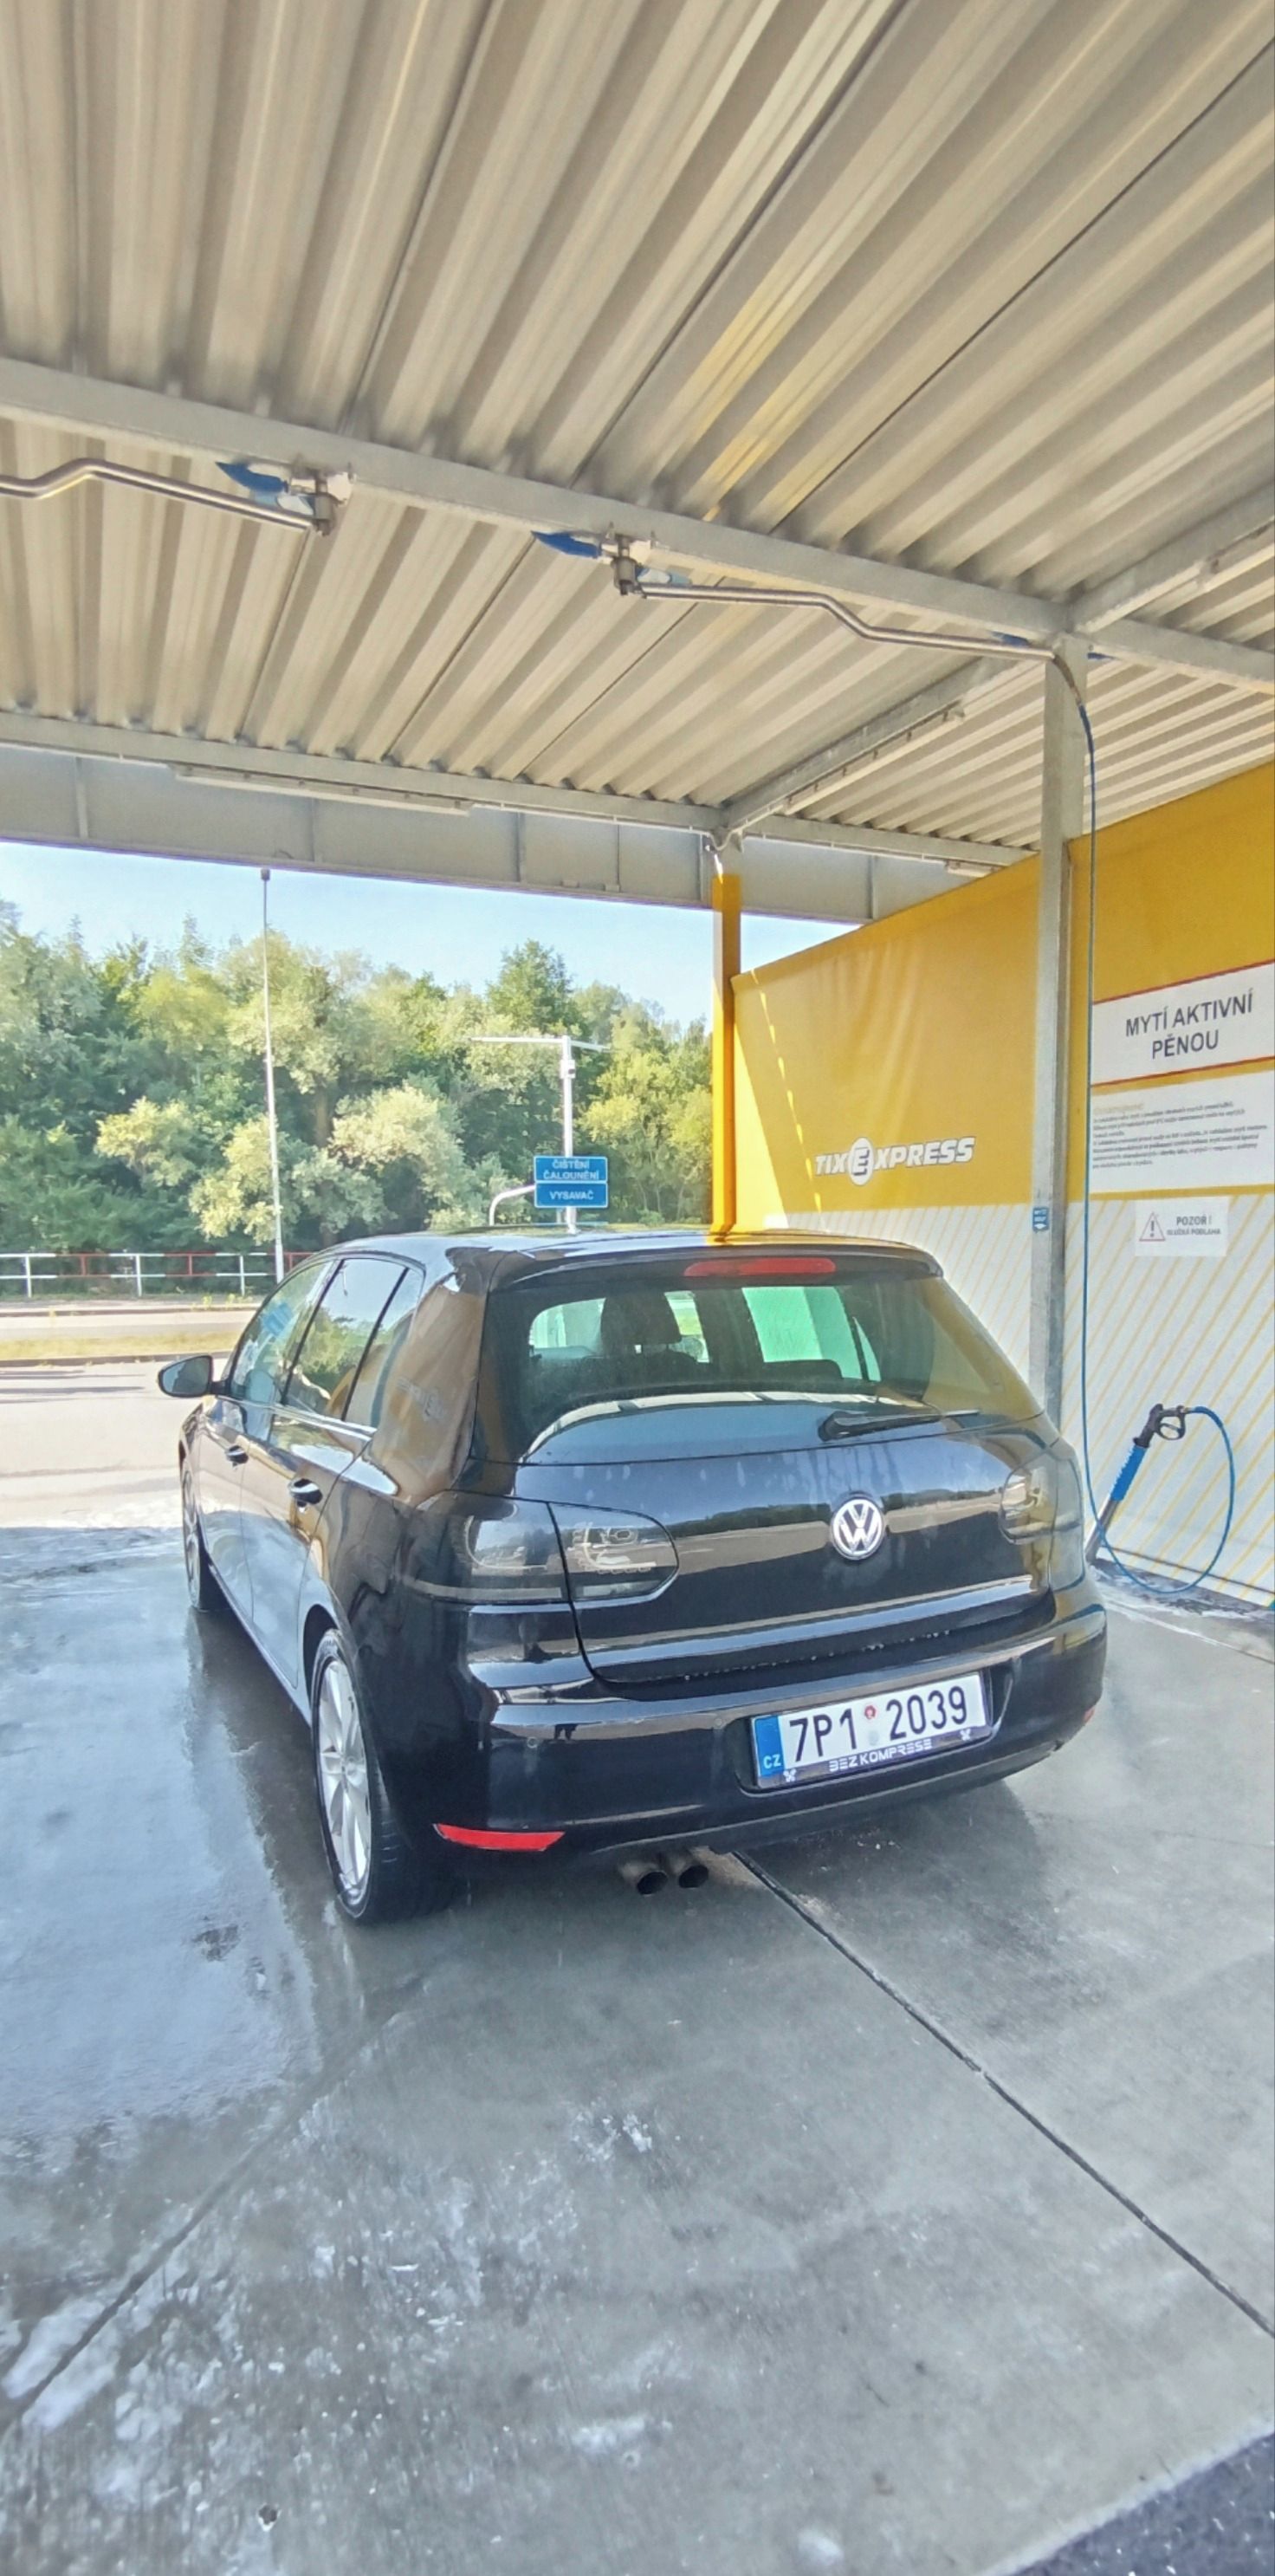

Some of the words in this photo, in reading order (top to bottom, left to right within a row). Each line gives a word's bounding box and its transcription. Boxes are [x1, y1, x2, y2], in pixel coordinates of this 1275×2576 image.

[1126, 1006, 1168, 1037] MYTÍ
[1172, 988, 1253, 1028] AKTIVNÍ
[1152, 1029, 1219, 1060] PĚNOU
[549, 1190, 594, 1200] VYSAVAČ
[789, 1708, 857, 1762] 7P1
[886, 1685, 968, 1741] 2039
[763, 1755, 781, 1769] CZ
[829, 1756, 858, 1773] BEZ
[859, 1738, 933, 1767] KOMPRESE
